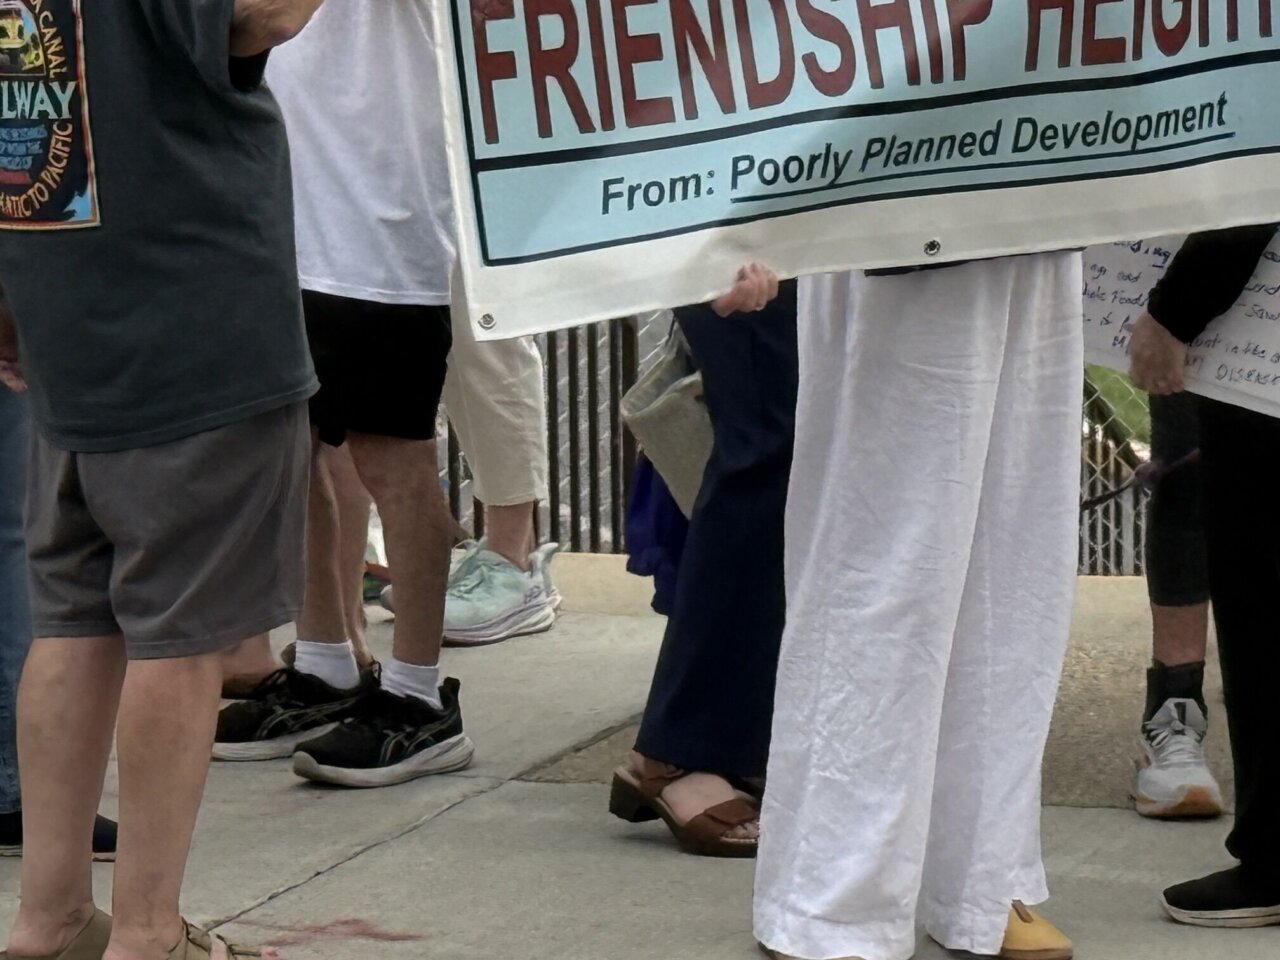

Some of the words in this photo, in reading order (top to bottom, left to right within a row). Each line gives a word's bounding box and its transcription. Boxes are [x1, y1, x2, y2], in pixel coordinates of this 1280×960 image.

[39, 10, 68, 79] CANAL
[26, 181, 49, 210] TO
[41, 121, 73, 190] PACIFIC
[602, 169, 715, 215] From:
[730, 142, 853, 190] Poorly
[859, 119, 1002, 172] Planned
[1011, 91, 1228, 155] Development
